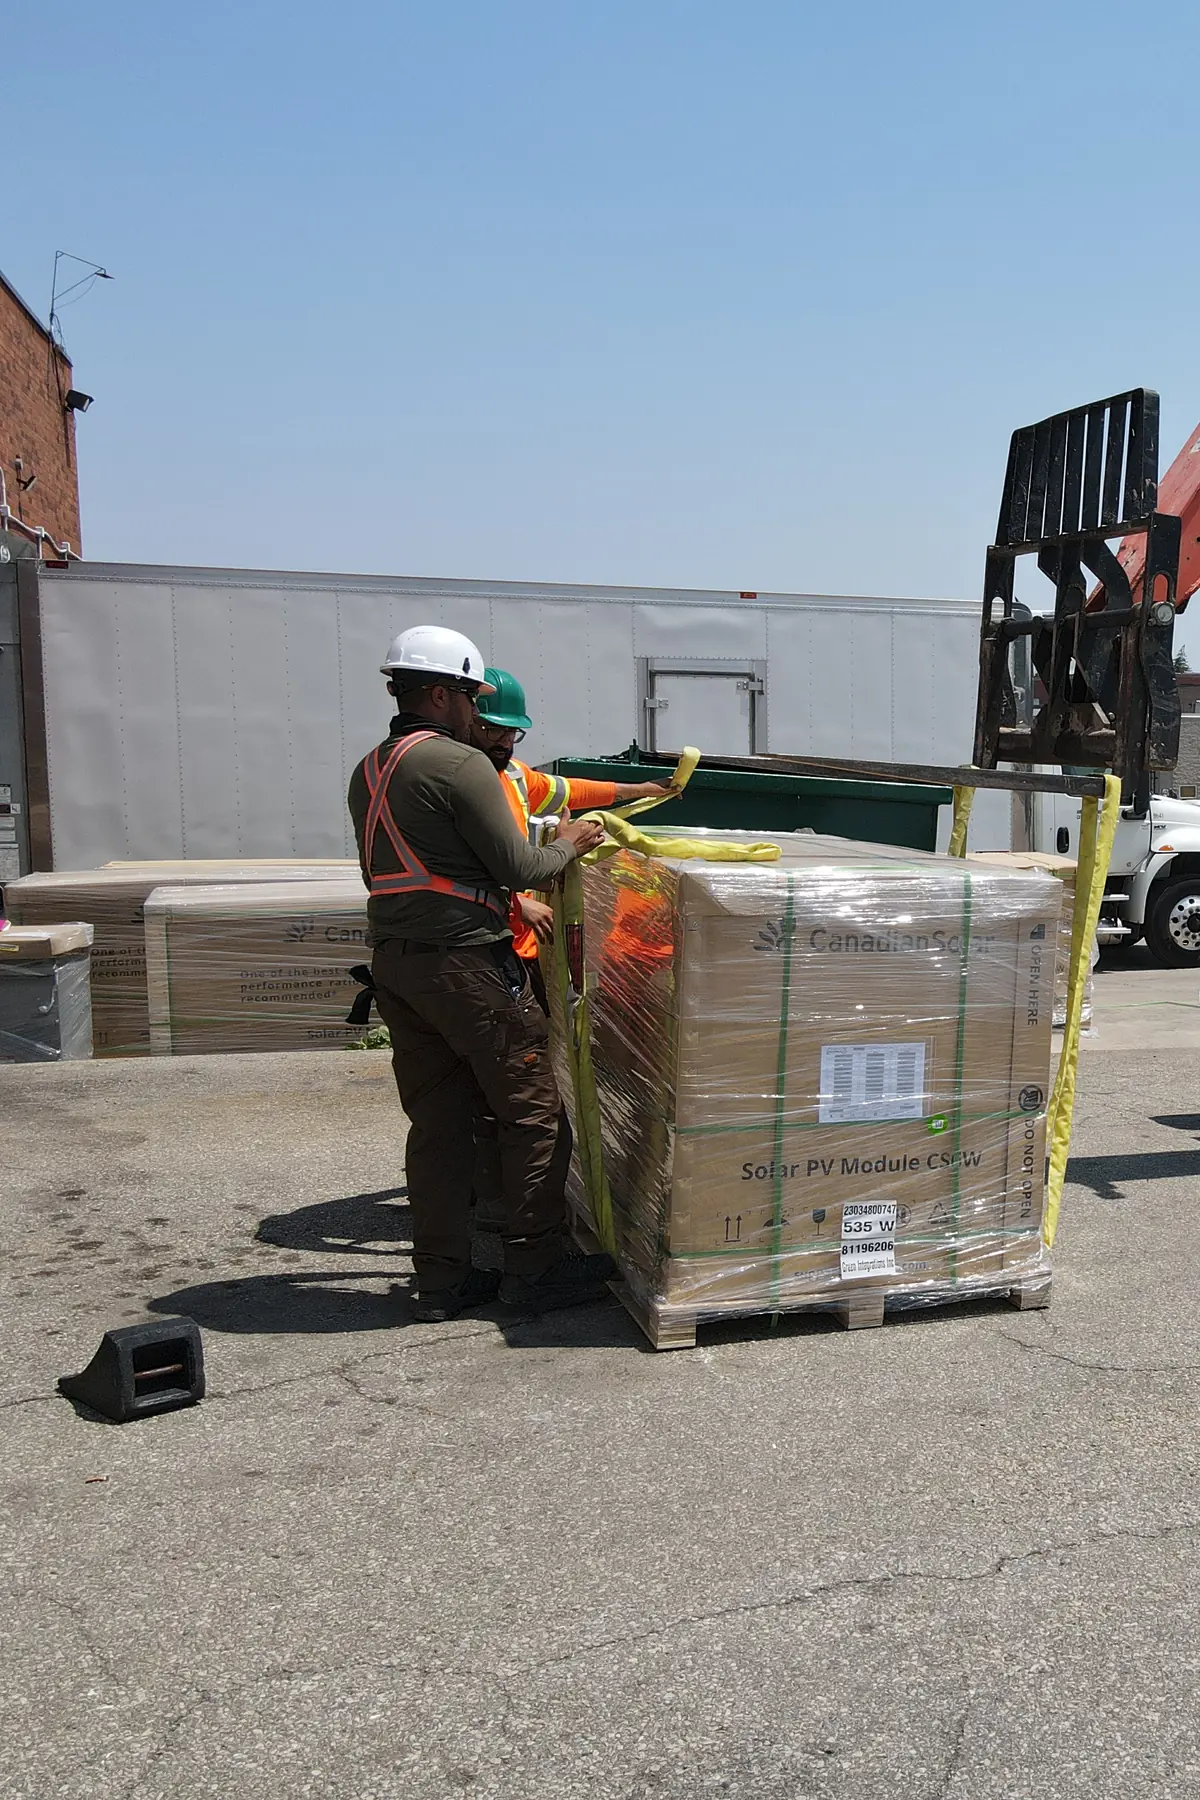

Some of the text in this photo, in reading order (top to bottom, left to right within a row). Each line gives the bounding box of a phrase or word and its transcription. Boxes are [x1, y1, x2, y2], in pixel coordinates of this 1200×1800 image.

[809, 928, 995, 953] CanadianSoar
[91, 948, 115, 956] One
[91, 959, 147, 968] perform
[91, 970, 147, 979] recomme
[240, 970, 265, 979] One
[270, 968, 283, 977] of
[288, 968, 309, 977] the
[313, 967, 340, 976] best
[240, 979, 323, 993] performance
[1027, 944, 1041, 1026] OPEN HERE
[307, 1028, 340, 1039] Solar
[741, 1160, 800, 1180] Solar
[806, 1159, 835, 1176] PV
[840, 1154, 920, 1175] Module
[1020, 1117, 1035, 1218] DO NOT OPEN
[843, 1204, 896, 1216] 23034800747
[843, 1220, 895, 1233] 535 W
[841, 1241, 894, 1255] 81196206
[841, 1262, 857, 1273] Green
[857, 1259, 886, 1273] Integrations
